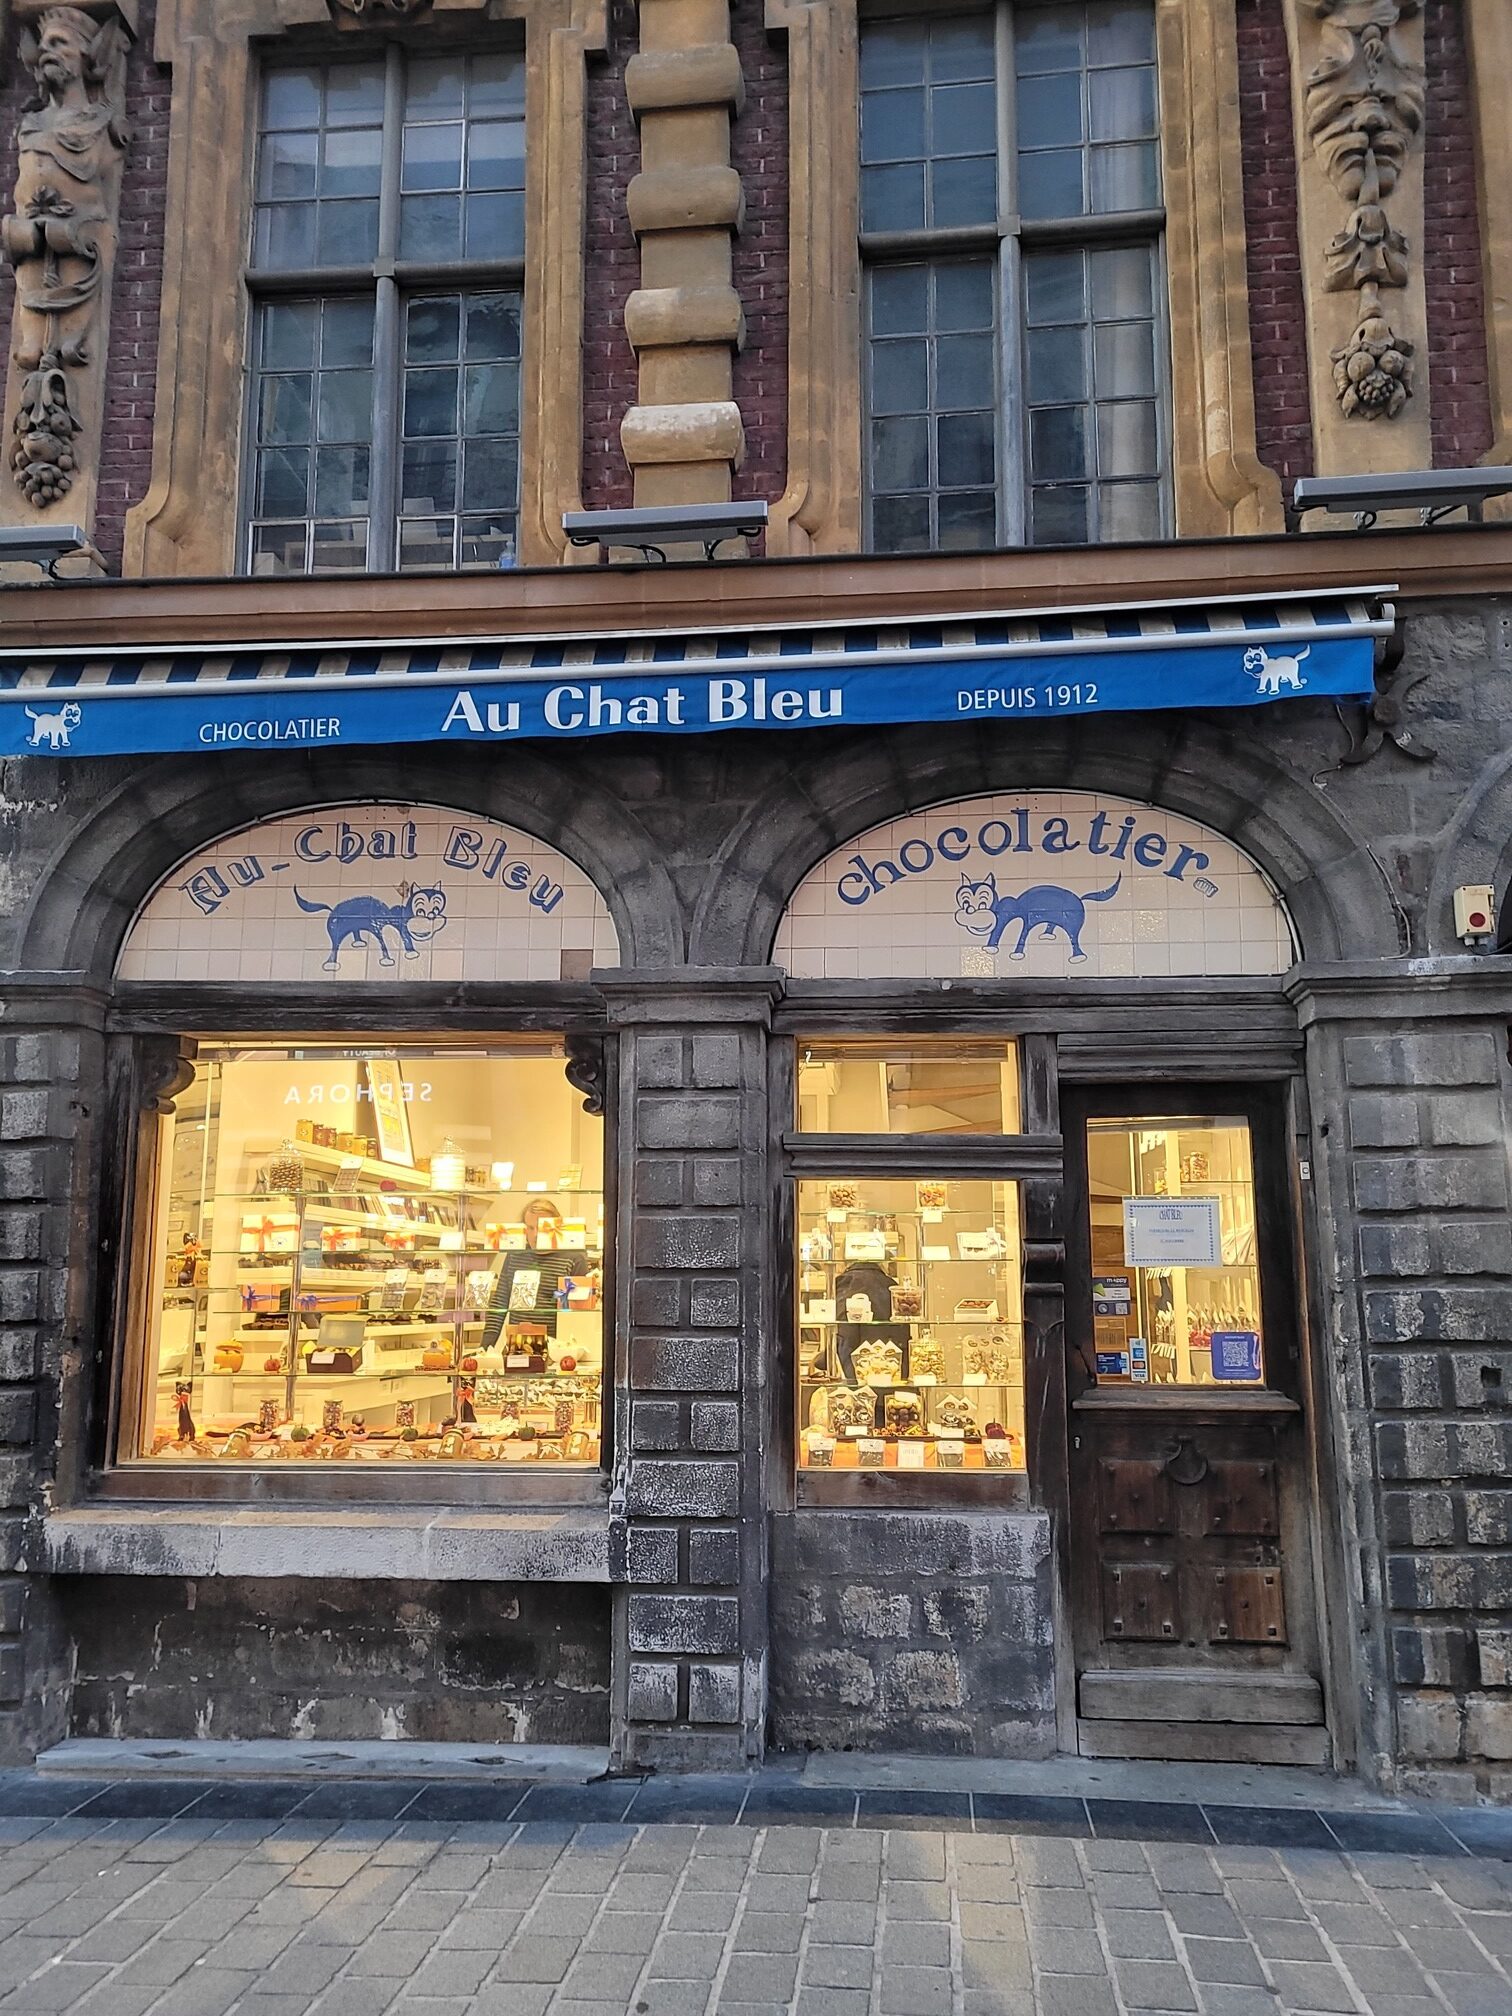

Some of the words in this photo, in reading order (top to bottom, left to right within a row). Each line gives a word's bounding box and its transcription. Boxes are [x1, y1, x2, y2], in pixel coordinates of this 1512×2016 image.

[440, 690, 520, 733] Au
[543, 684, 686, 730] Chat
[708, 677, 843, 723] Bleu
[957, 686, 1036, 711] DEPUIS
[1044, 683, 1098, 707] 1912
[199, 717, 342, 743] CHOCOLATIER
[443, 825, 564, 914] Bleu
[836, 808, 1211, 906] chocolatier
